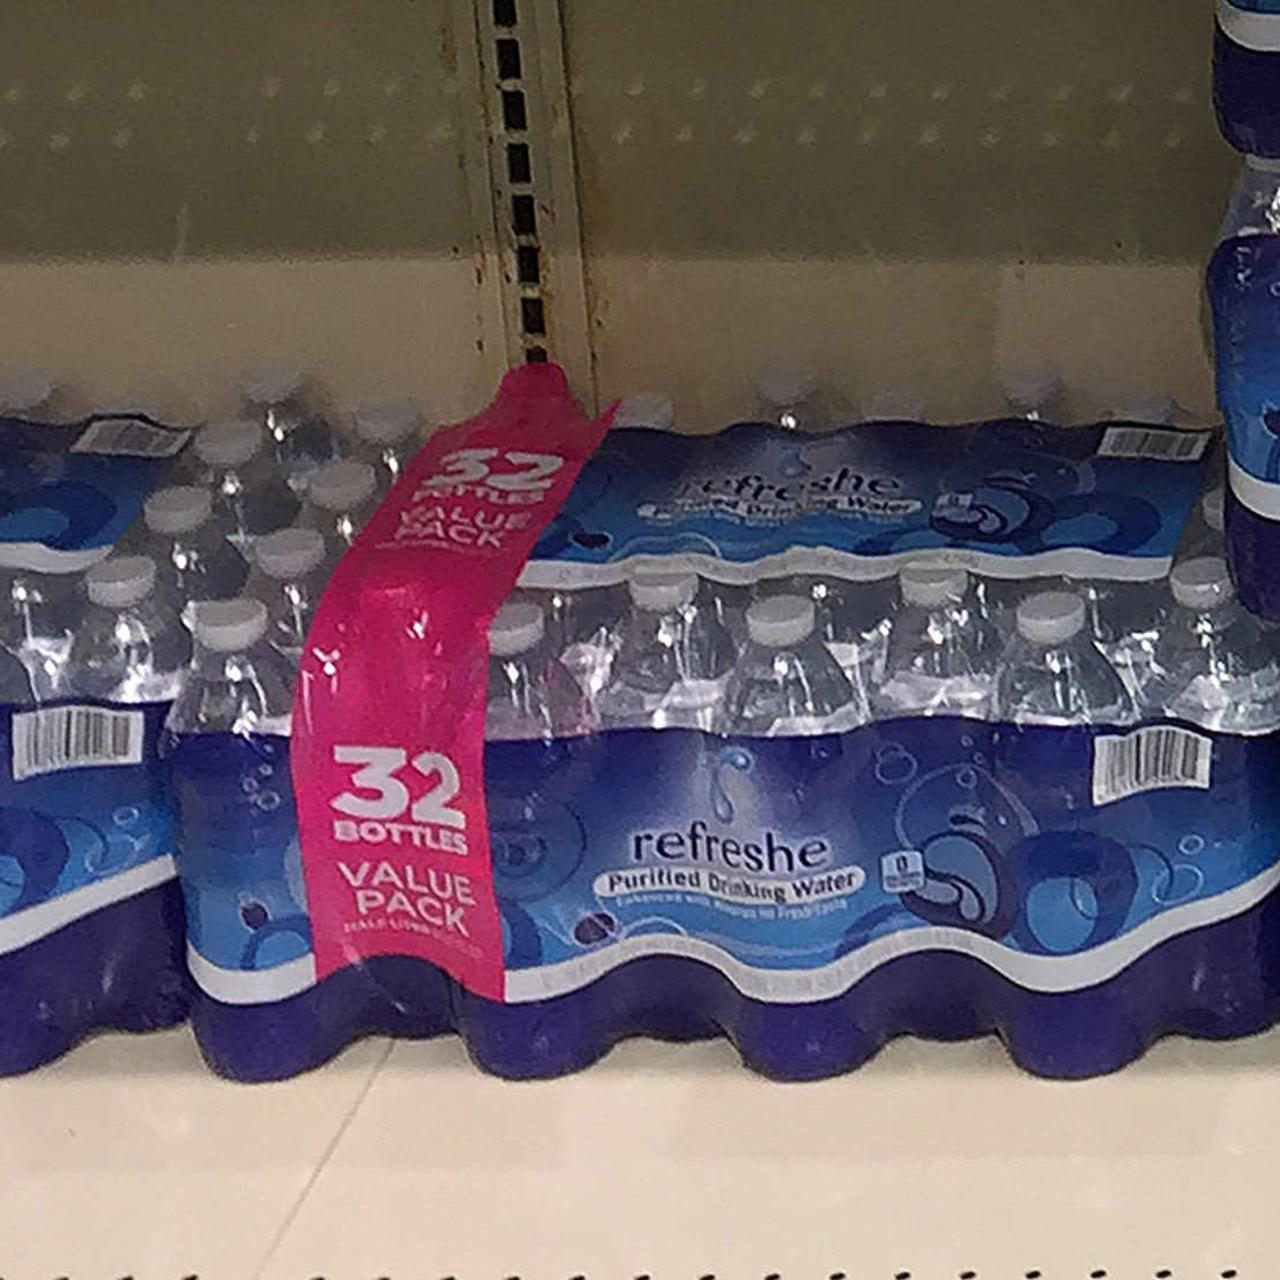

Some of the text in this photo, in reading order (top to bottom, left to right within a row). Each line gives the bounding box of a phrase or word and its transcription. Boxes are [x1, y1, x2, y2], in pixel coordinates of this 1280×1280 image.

[422, 447, 564, 491] 32
[329, 745, 466, 829] 32
[333, 819, 468, 856] BOTTLES
[633, 820, 828, 872] refreshe
[337, 861, 476, 906] VALUE
[608, 869, 700, 892] Purified
[708, 872, 787, 904] Drinking
[792, 871, 856, 898] Water
[355, 889, 470, 938] PACK
